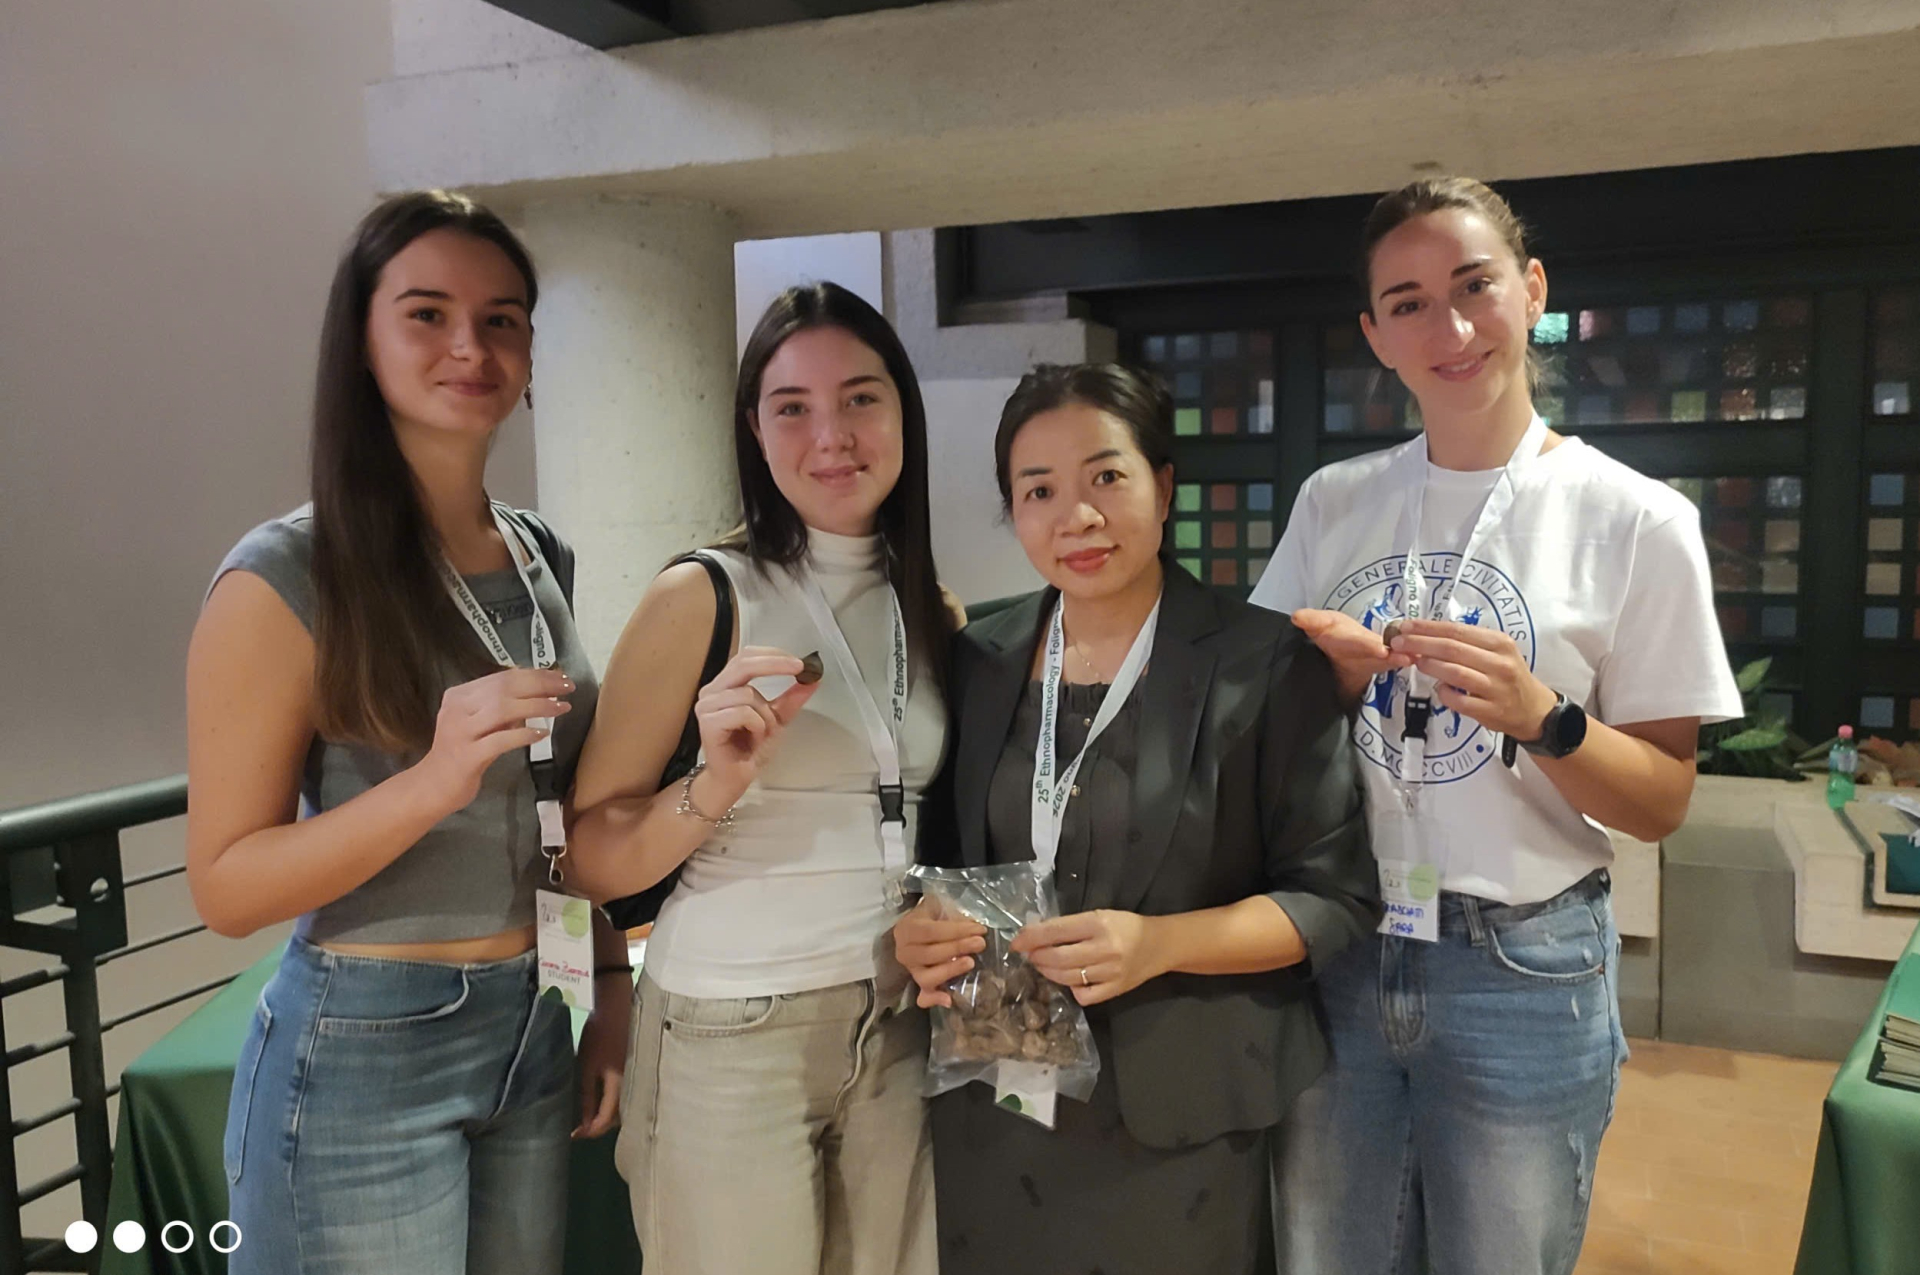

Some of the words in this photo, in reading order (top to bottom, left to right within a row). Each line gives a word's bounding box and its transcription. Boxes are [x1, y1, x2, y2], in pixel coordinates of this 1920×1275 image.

[1461, 564, 1527, 642] CIVITATIS
[1039, 665, 1060, 776] Ethnopharmacology
[1036, 780, 1050, 804] 25th
